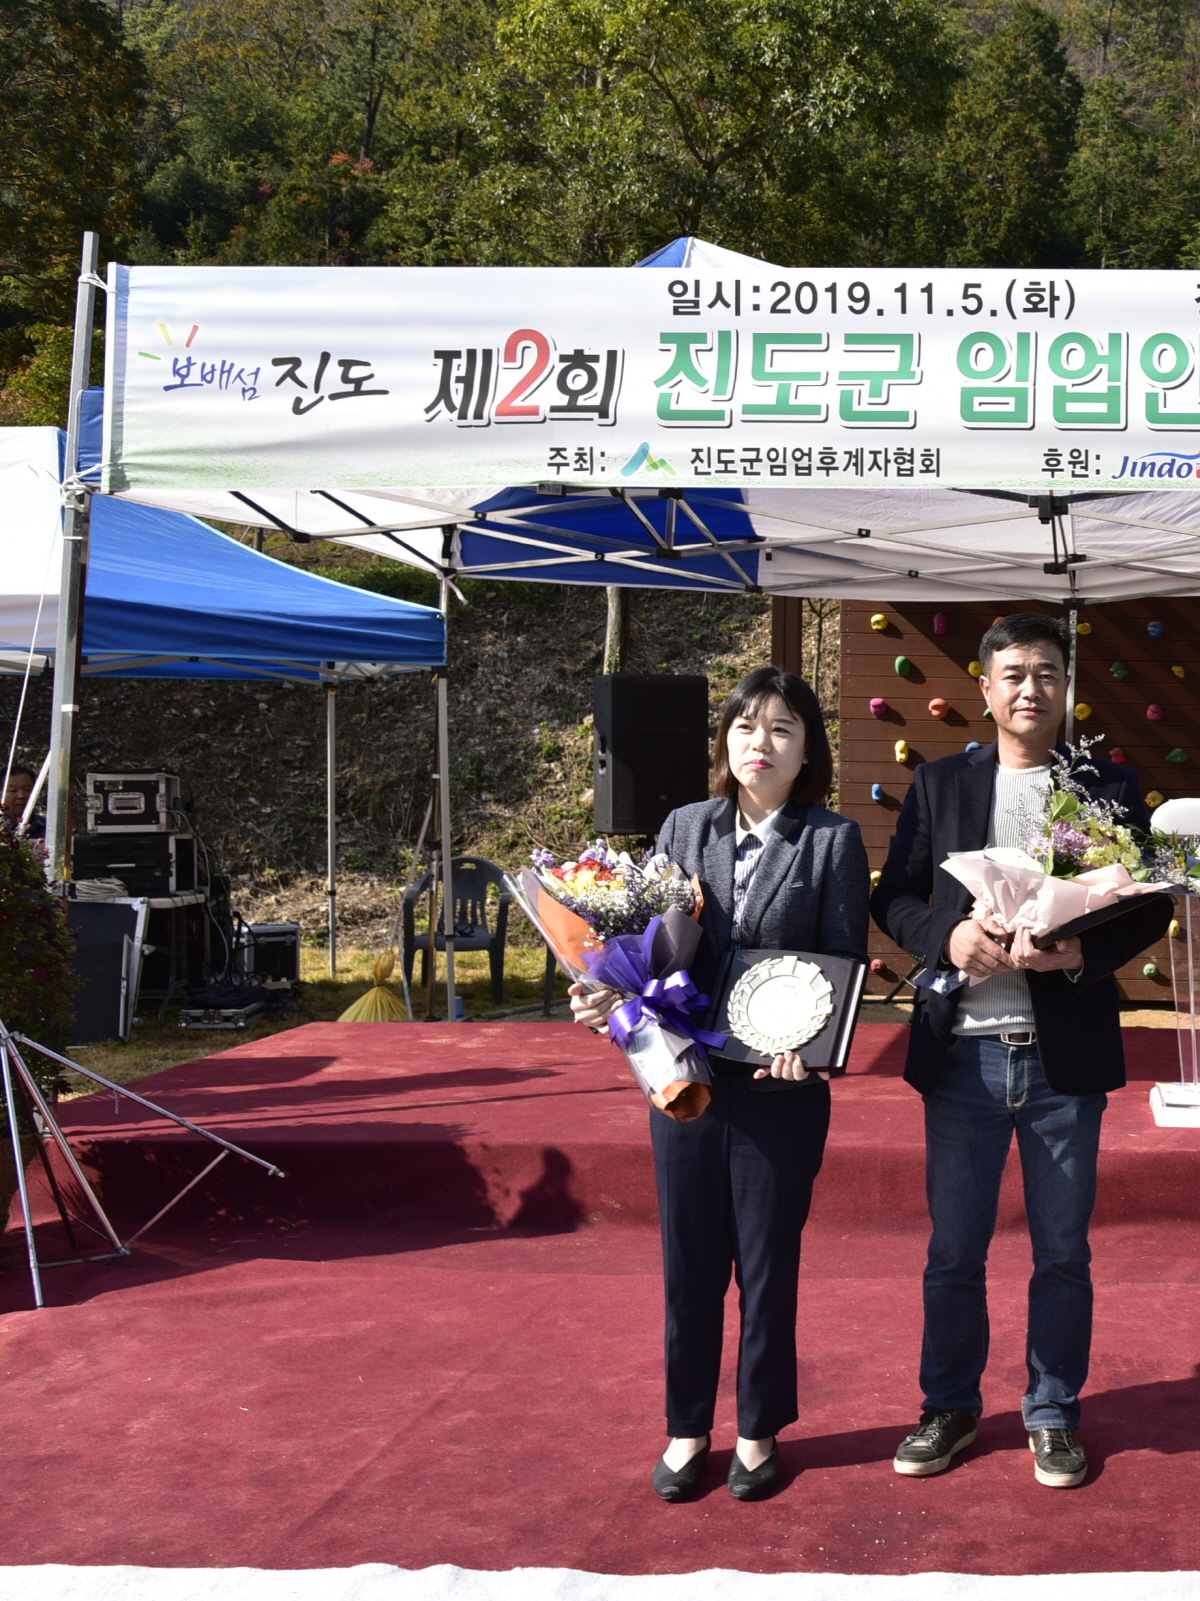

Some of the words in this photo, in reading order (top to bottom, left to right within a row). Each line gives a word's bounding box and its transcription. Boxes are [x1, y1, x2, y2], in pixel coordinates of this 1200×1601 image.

[667, 279, 1077, 321] 일시:2019.11.5.(화)
[162, 356, 262, 402] 보배섬
[272, 351, 390, 416] 진도
[425, 328, 620, 427] 제2회
[653, 329, 920, 427] 진도군
[547, 446, 608, 476] 주최:
[690, 447, 942, 479] 진도군임업후계자협회
[1041, 449, 1103, 480] 후원:
[1111, 455, 1194, 480] Jindo
